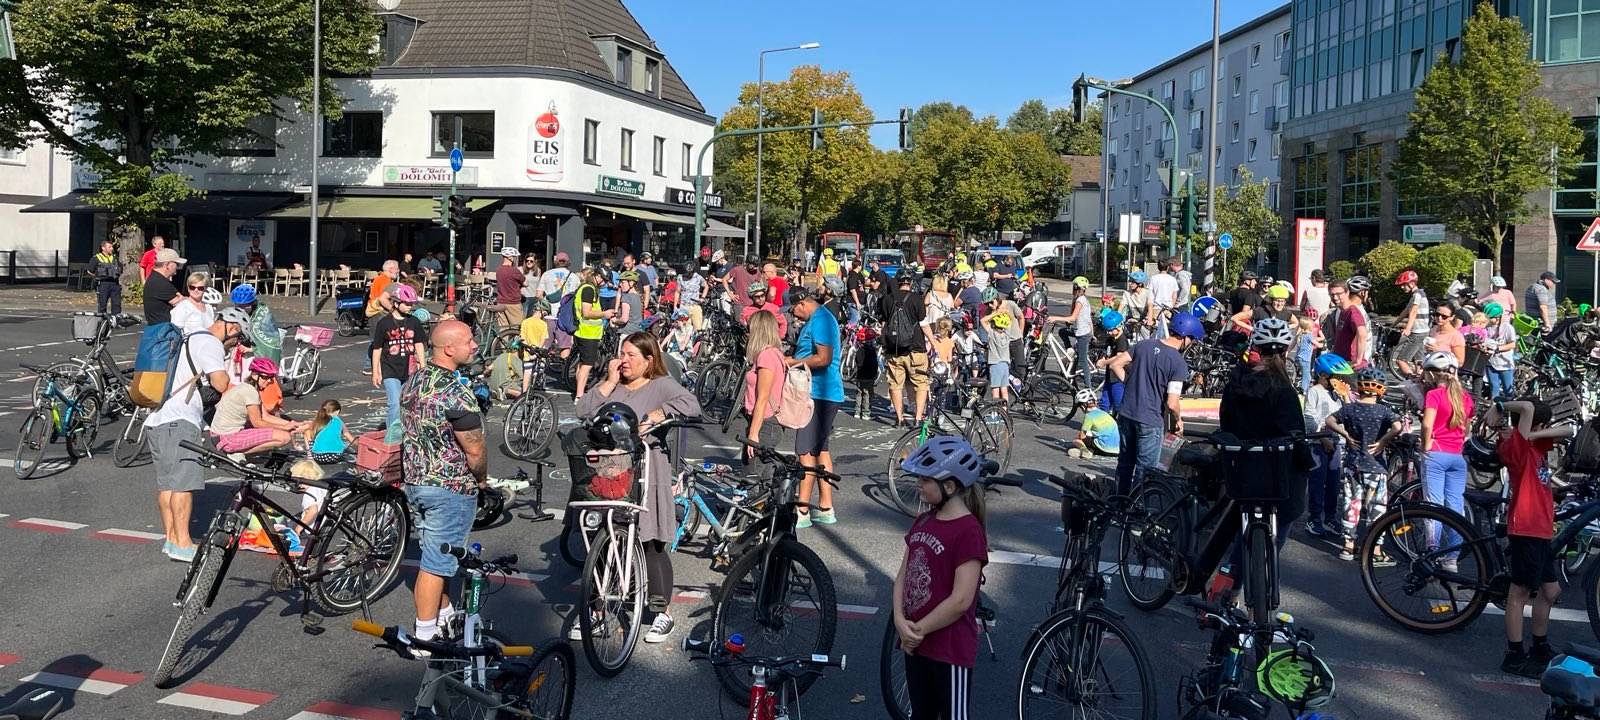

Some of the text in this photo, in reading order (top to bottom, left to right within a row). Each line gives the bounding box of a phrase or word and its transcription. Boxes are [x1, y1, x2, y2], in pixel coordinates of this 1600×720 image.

[533, 140, 559, 155] EIS
[533, 154, 559, 166] Café
[401, 173, 454, 181] DOLOMIT
[610, 185, 637, 194] DOLOMITI
[685, 191, 722, 207] COAINER
